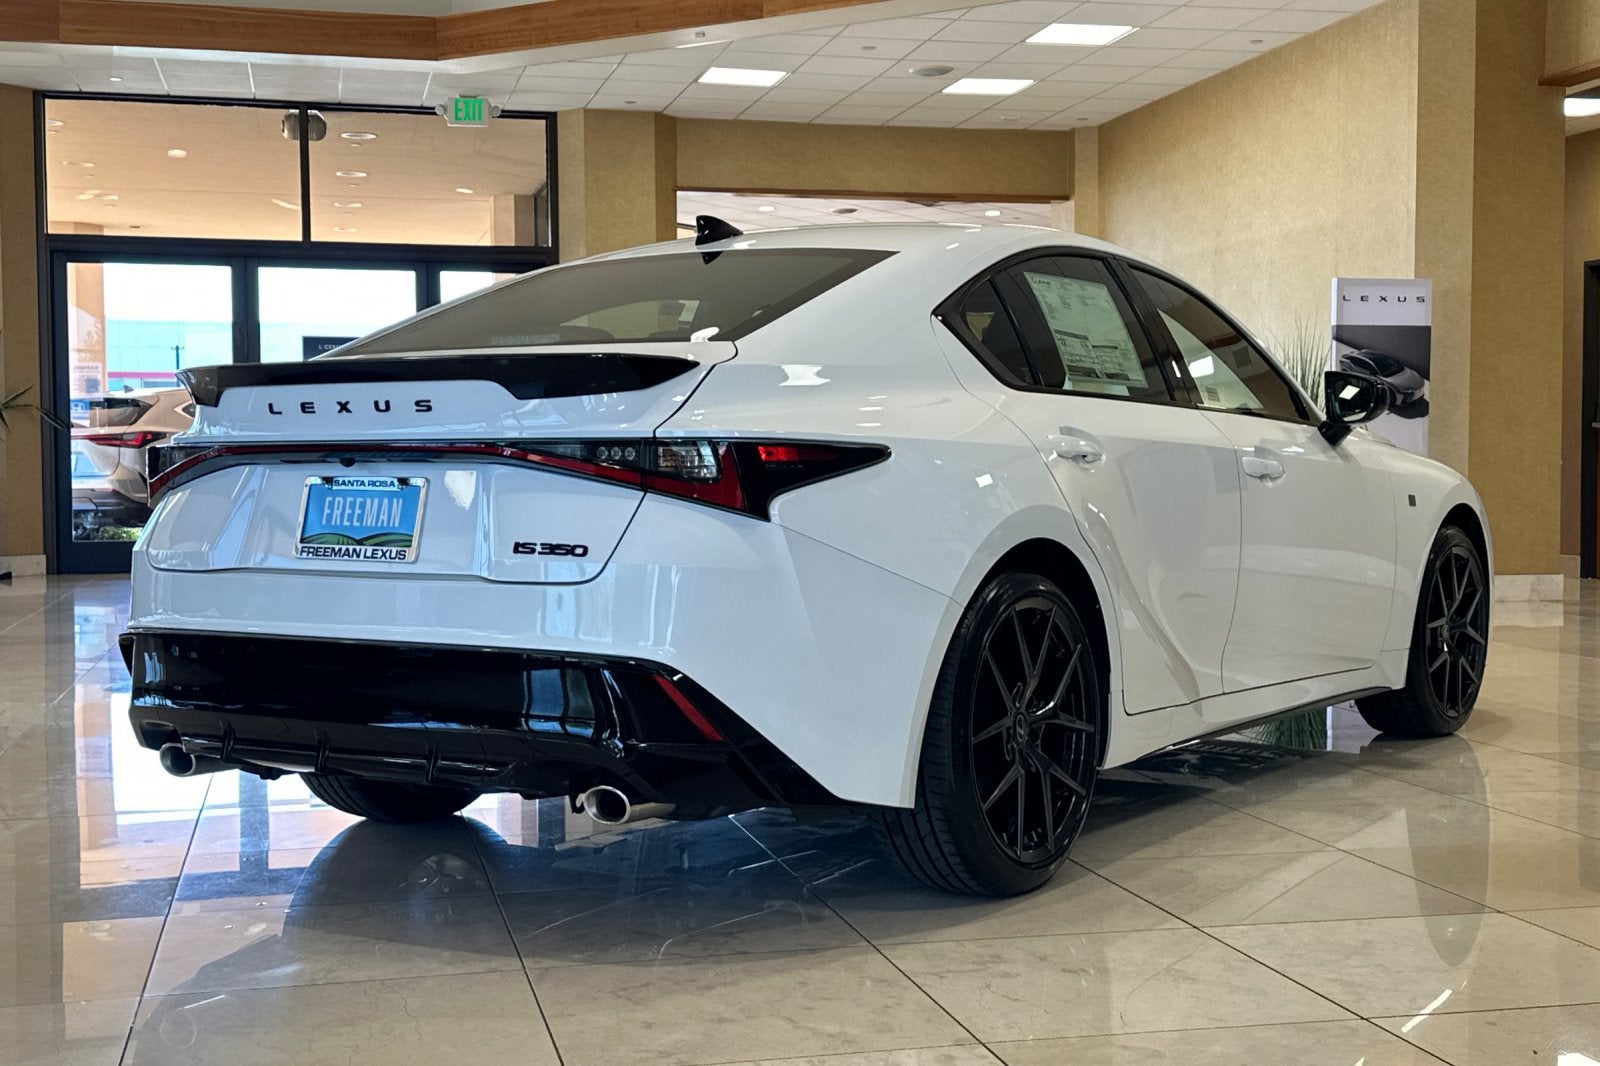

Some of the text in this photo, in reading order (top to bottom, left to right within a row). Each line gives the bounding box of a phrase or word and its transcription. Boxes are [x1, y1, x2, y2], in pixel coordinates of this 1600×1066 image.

[454, 99, 483, 121] EXIT
[1342, 295, 1426, 303] LEXUS
[268, 399, 433, 415] LEXUS
[333, 479, 396, 488] SANTA ROSA
[321, 496, 403, 528] FREEMAN
[300, 546, 407, 560] FREEMAN LEXUS
